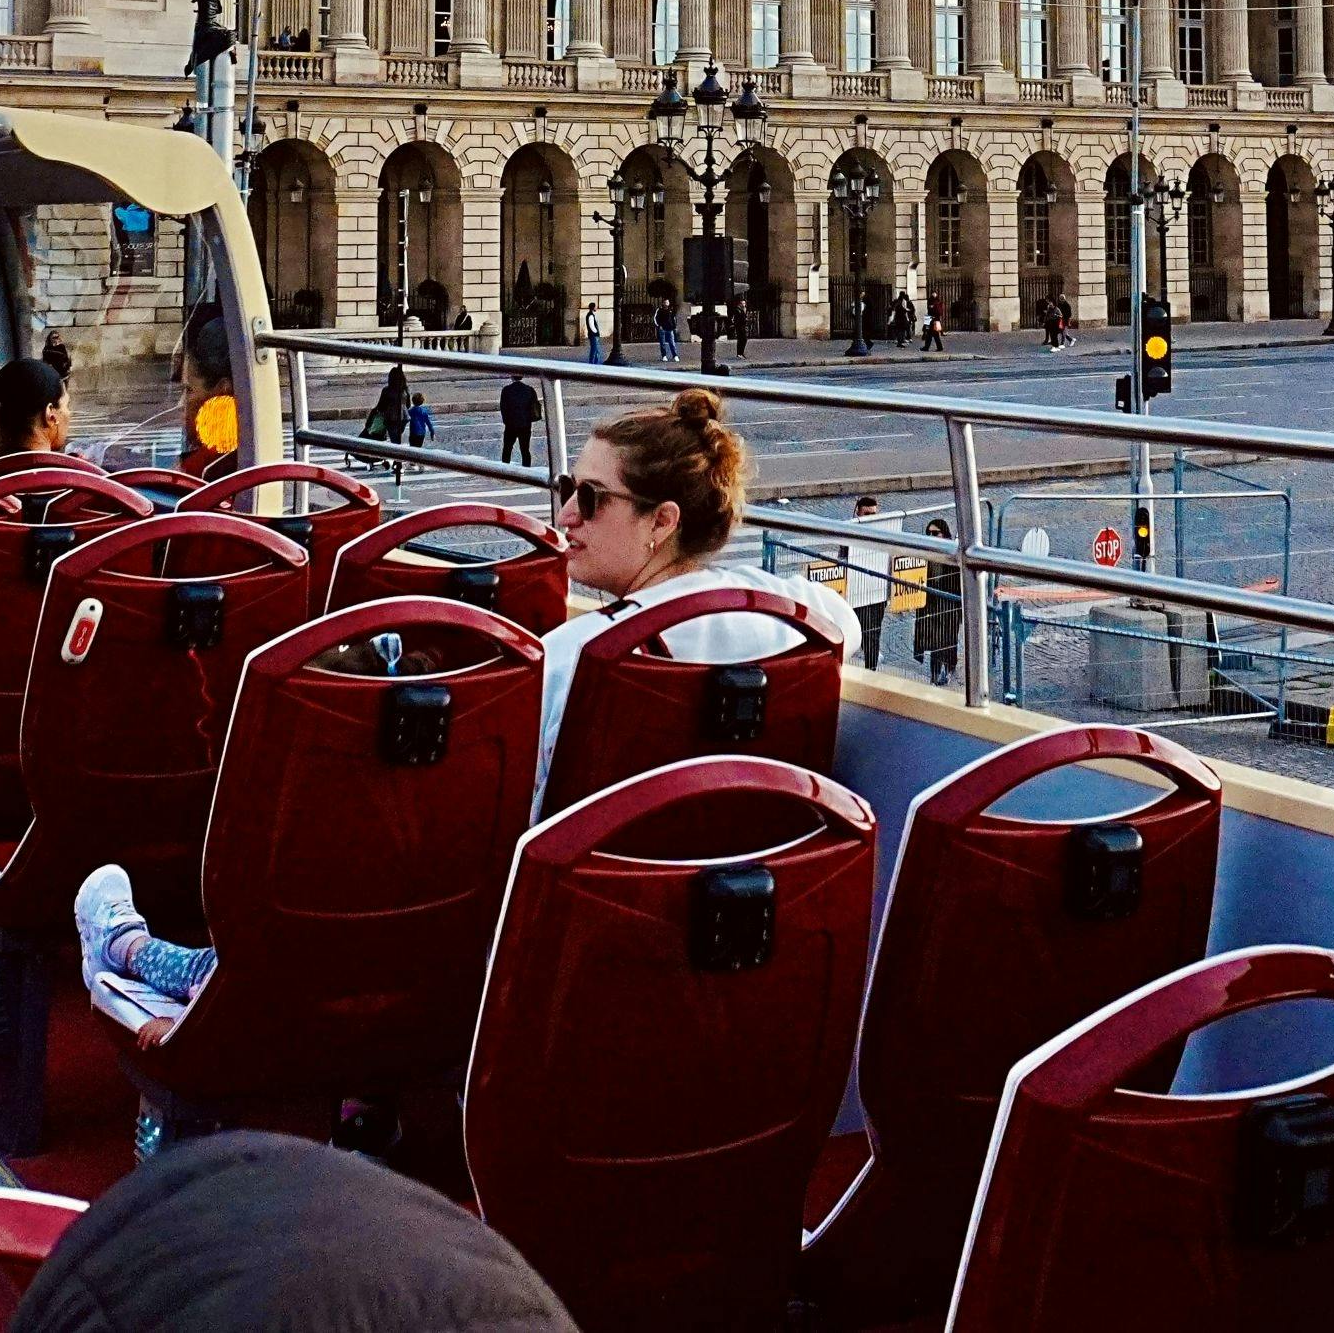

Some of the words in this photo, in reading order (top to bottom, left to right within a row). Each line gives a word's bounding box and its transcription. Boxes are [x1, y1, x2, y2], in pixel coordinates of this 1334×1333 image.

[1095, 539, 1119, 561] STOP
[894, 557, 926, 571] ATTENTION
[809, 566, 844, 582] ATTENTION
